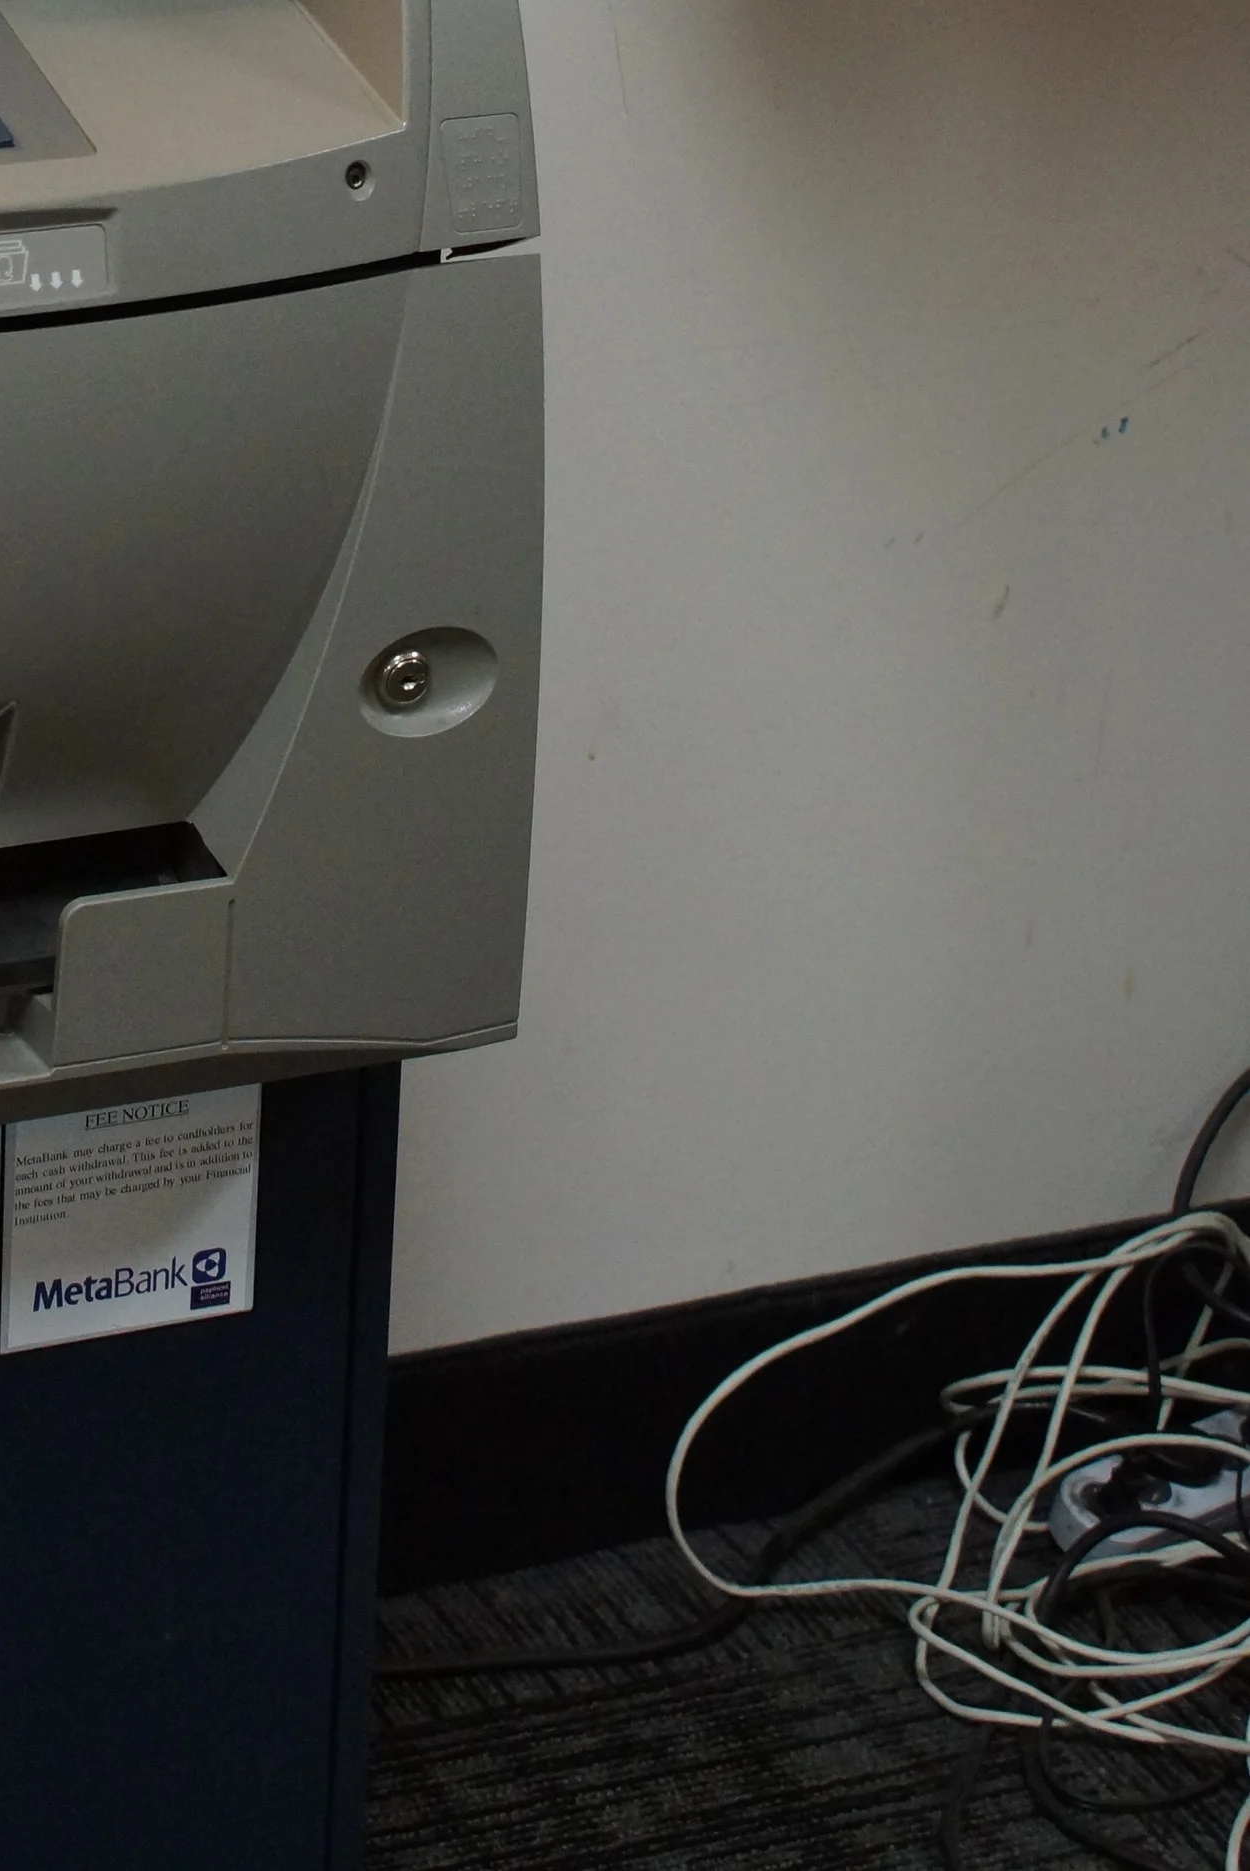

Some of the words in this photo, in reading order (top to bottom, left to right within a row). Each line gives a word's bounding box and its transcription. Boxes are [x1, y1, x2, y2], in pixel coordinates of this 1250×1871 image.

[85, 1110, 120, 1129] FEE
[123, 1099, 190, 1124] NOTICE
[16, 1150, 68, 1167] MetaBank
[73, 1148, 94, 1159] may
[98, 1141, 131, 1156] charge
[164, 1133, 175, 1144] to
[133, 1151, 156, 1164] This
[33, 1255, 189, 1312] MetaBank
